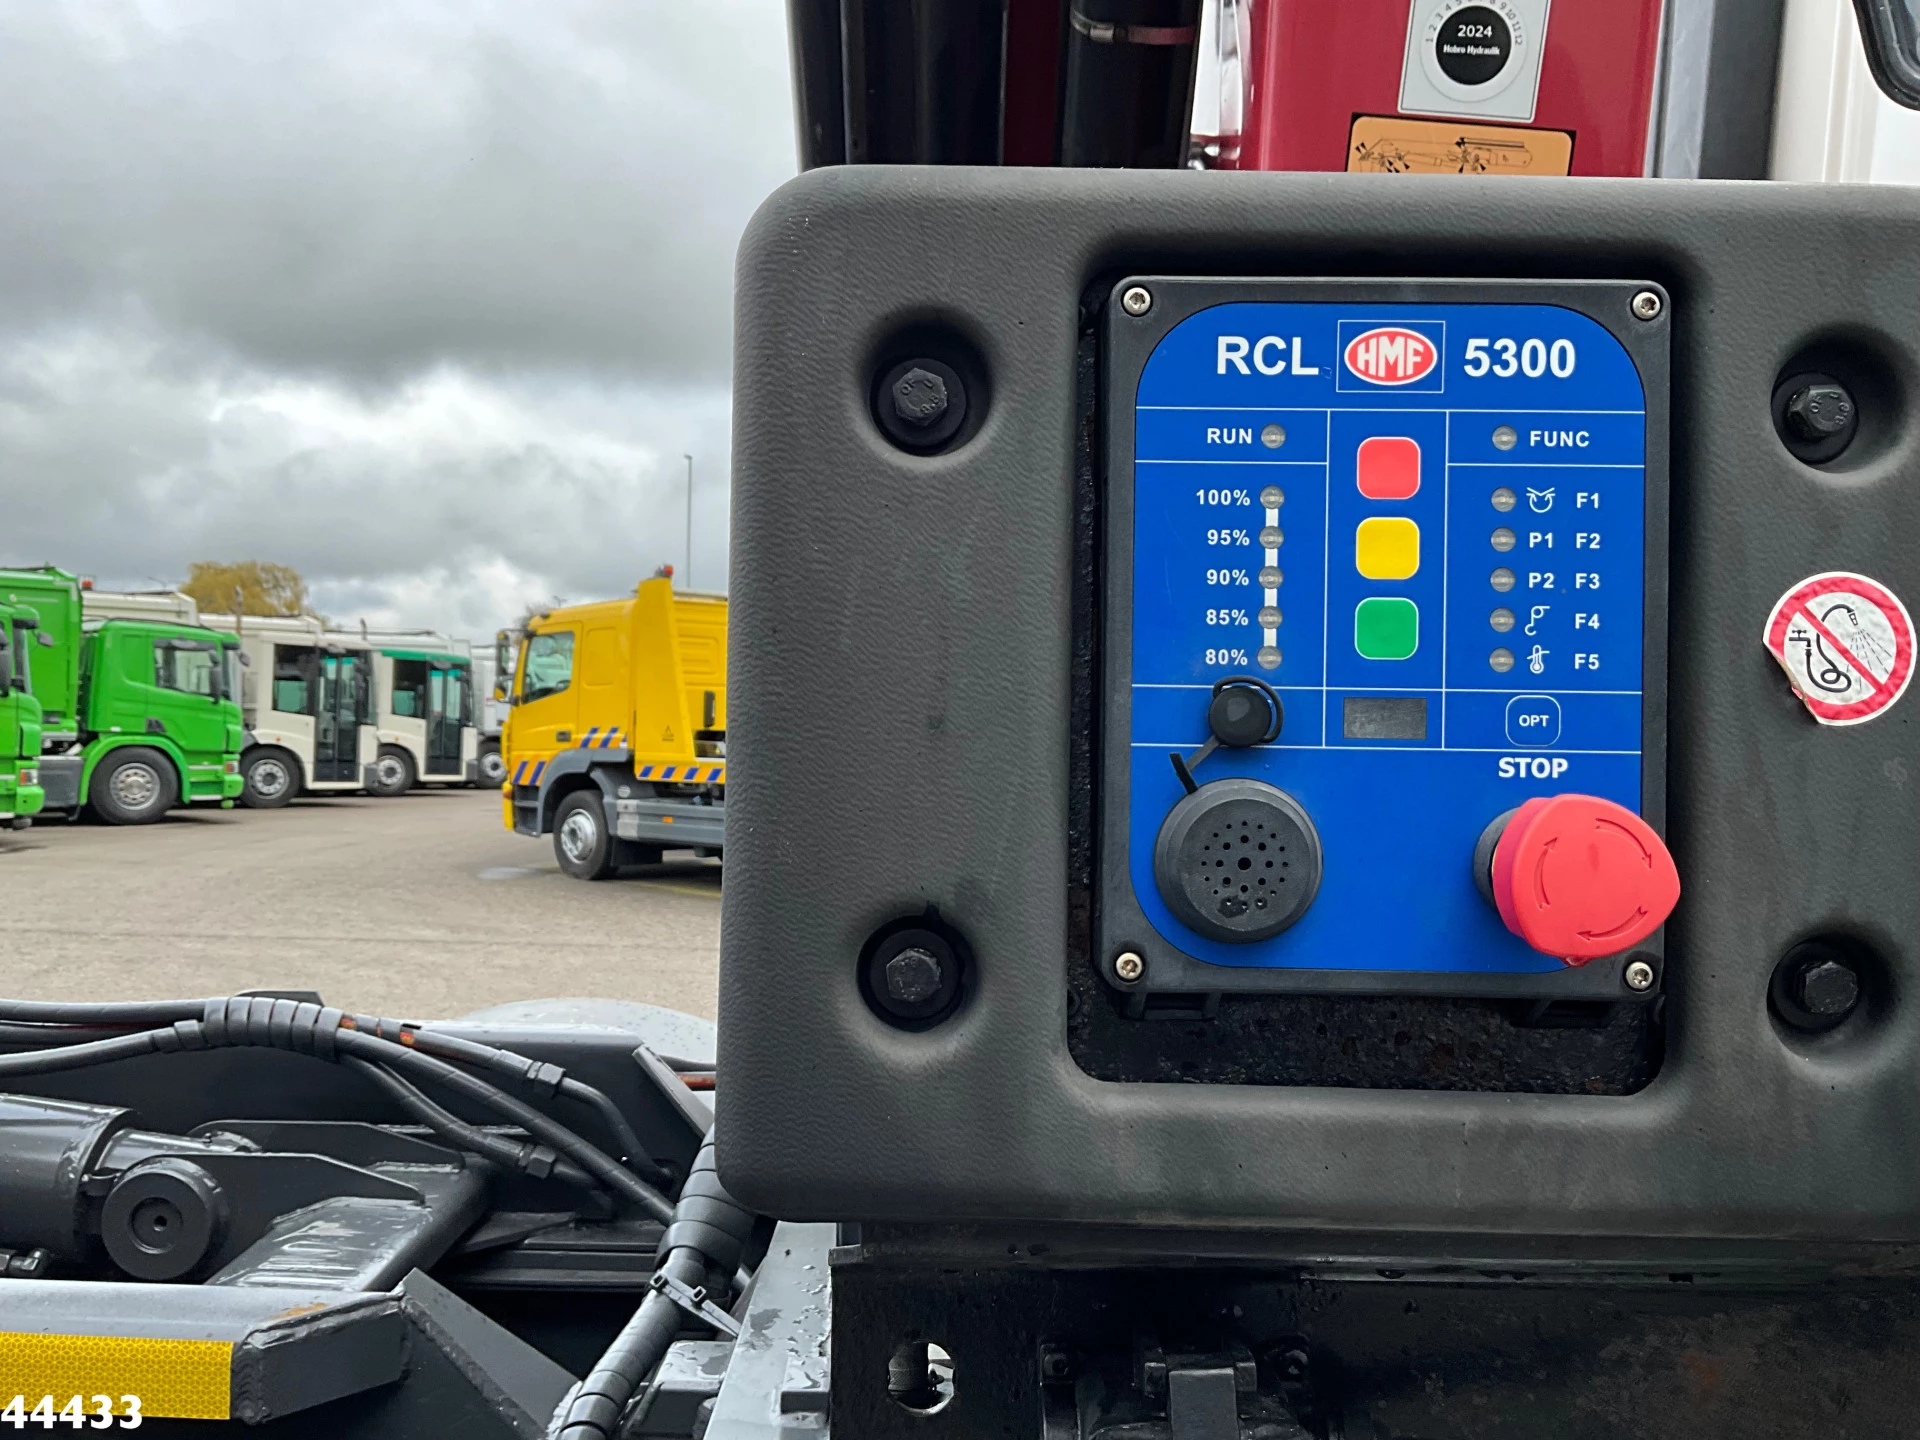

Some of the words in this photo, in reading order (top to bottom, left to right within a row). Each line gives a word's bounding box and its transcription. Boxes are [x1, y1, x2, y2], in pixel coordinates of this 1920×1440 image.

[1457, 24, 1493, 38] 2024
[1217, 335, 1319, 376] RCL
[1356, 336, 1425, 380] HMF
[1464, 338, 1575, 378] 5300
[1207, 427, 1252, 444] RUN
[1530, 430, 1589, 447] FUNC
[1196, 489, 1251, 506] 100%
[1576, 492, 1599, 509] F1
[1207, 529, 1250, 546] 95%
[1529, 532, 1553, 548] P1
[1576, 532, 1600, 549] F2
[1206, 569, 1249, 586] 90%
[1528, 572, 1554, 589] P2
[1575, 573, 1600, 589] F3
[1206, 609, 1249, 626] 85%
[1575, 613, 1600, 629] F4
[1205, 648, 1248, 666] 80%
[1574, 653, 1599, 670] F5
[1518, 714, 1549, 727] OPT
[1498, 757, 1568, 779] STOP
